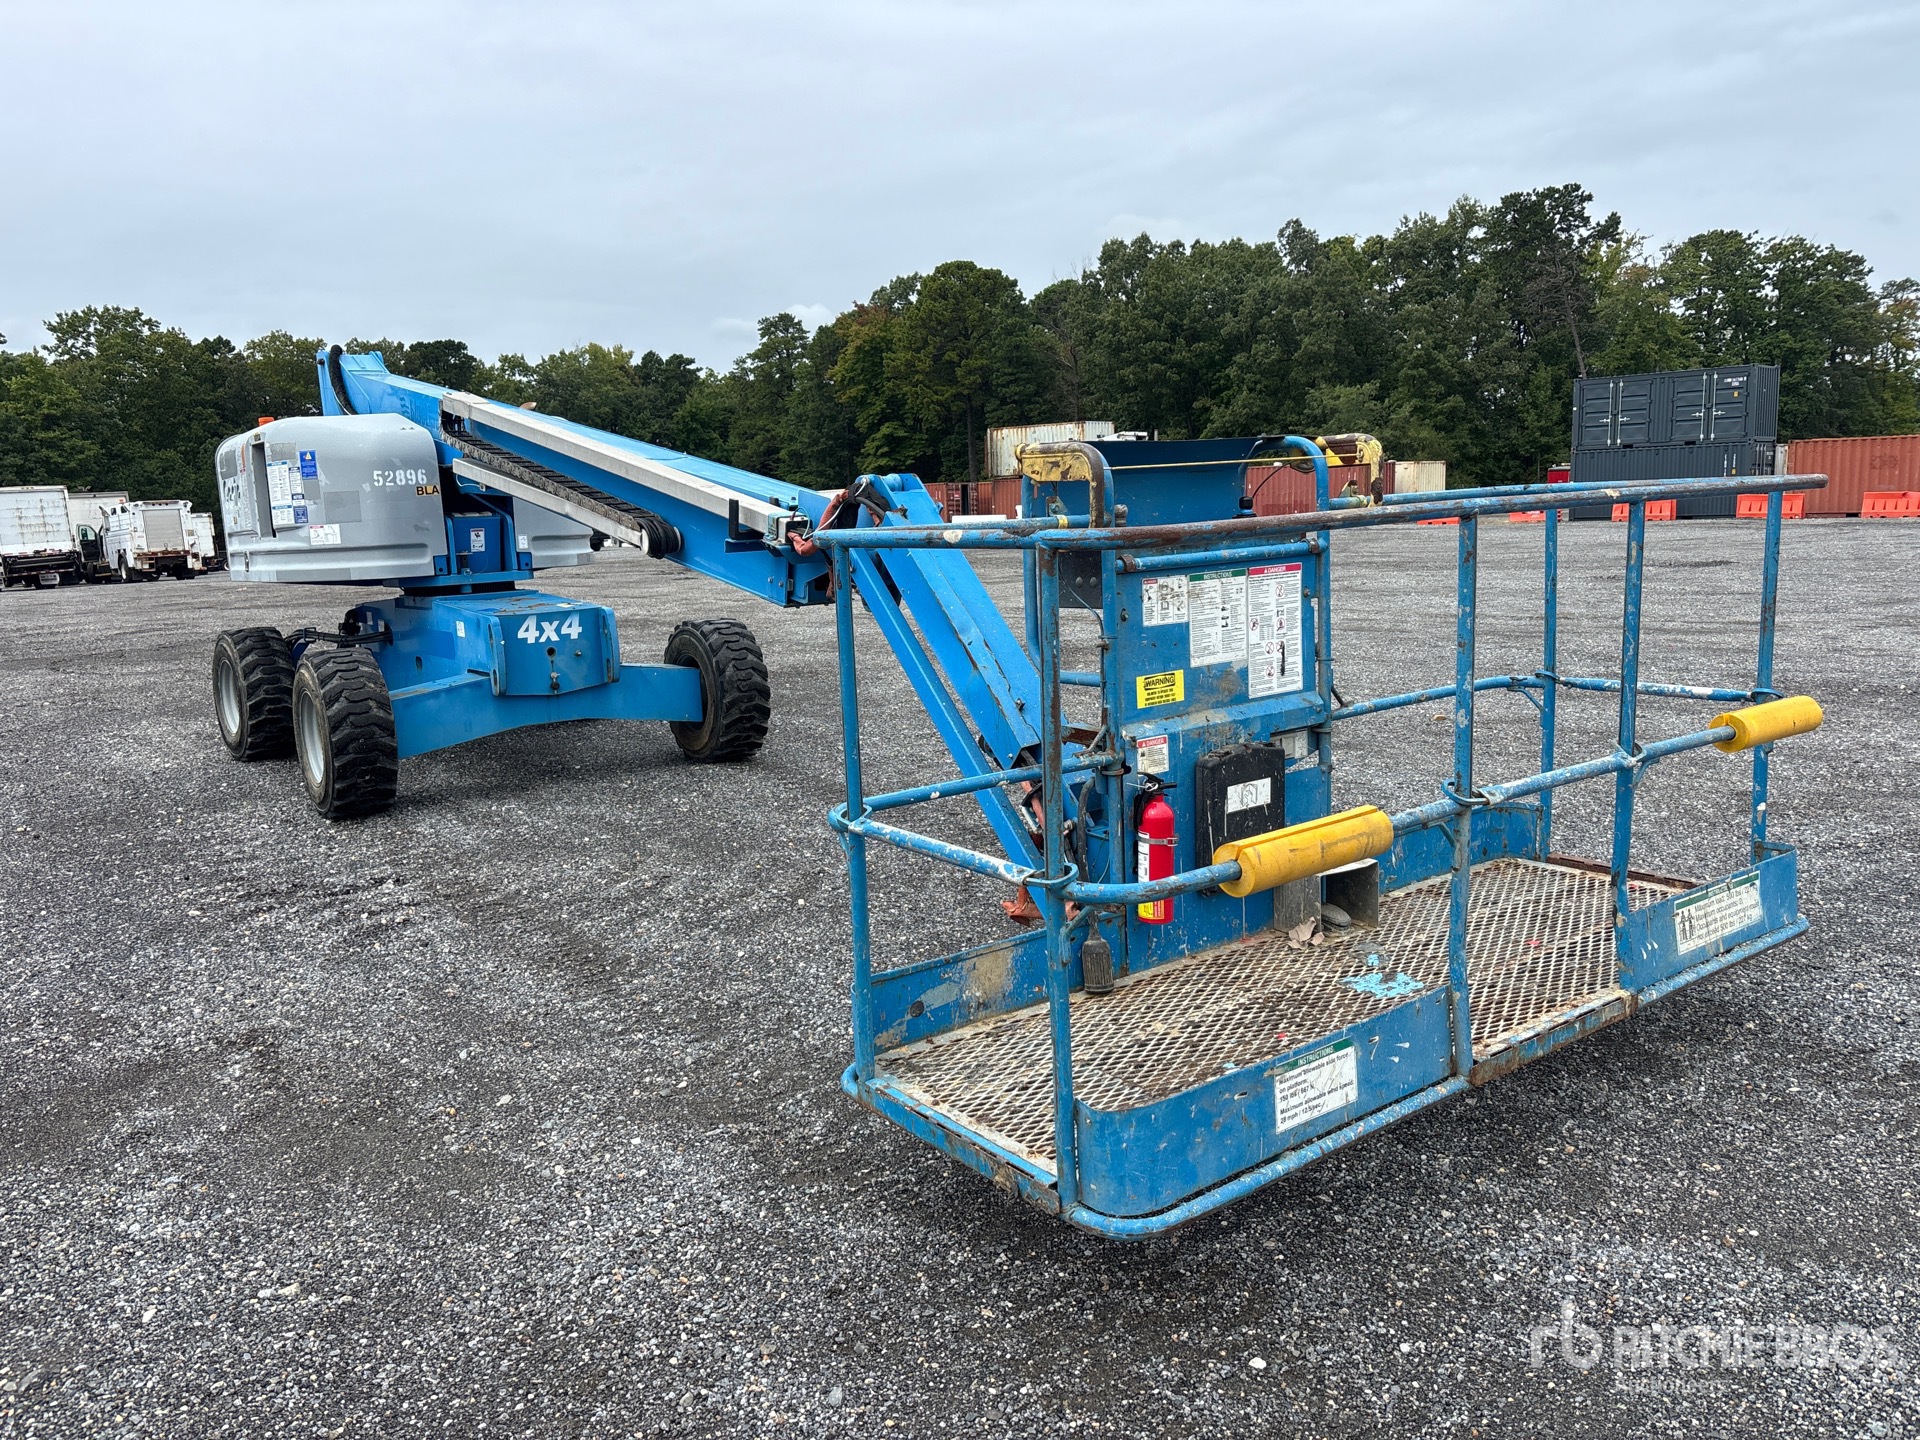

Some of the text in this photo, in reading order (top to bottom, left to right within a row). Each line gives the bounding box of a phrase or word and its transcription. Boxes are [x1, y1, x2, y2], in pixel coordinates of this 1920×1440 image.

[373, 468, 428, 487] 52896
[416, 485, 440, 496] BLA
[1203, 571, 1233, 580] INSTRUCTIONS
[1266, 565, 1287, 574] DANGER
[517, 612, 583, 644] 4x4
[1145, 676, 1175, 688] WARNING
[1297, 1045, 1334, 1067] INSTRUCTIONS
[1303, 1061, 1326, 1076] allowable
[1280, 1101, 1304, 1115] Maximum
[1304, 1091, 1327, 1105] allowable
